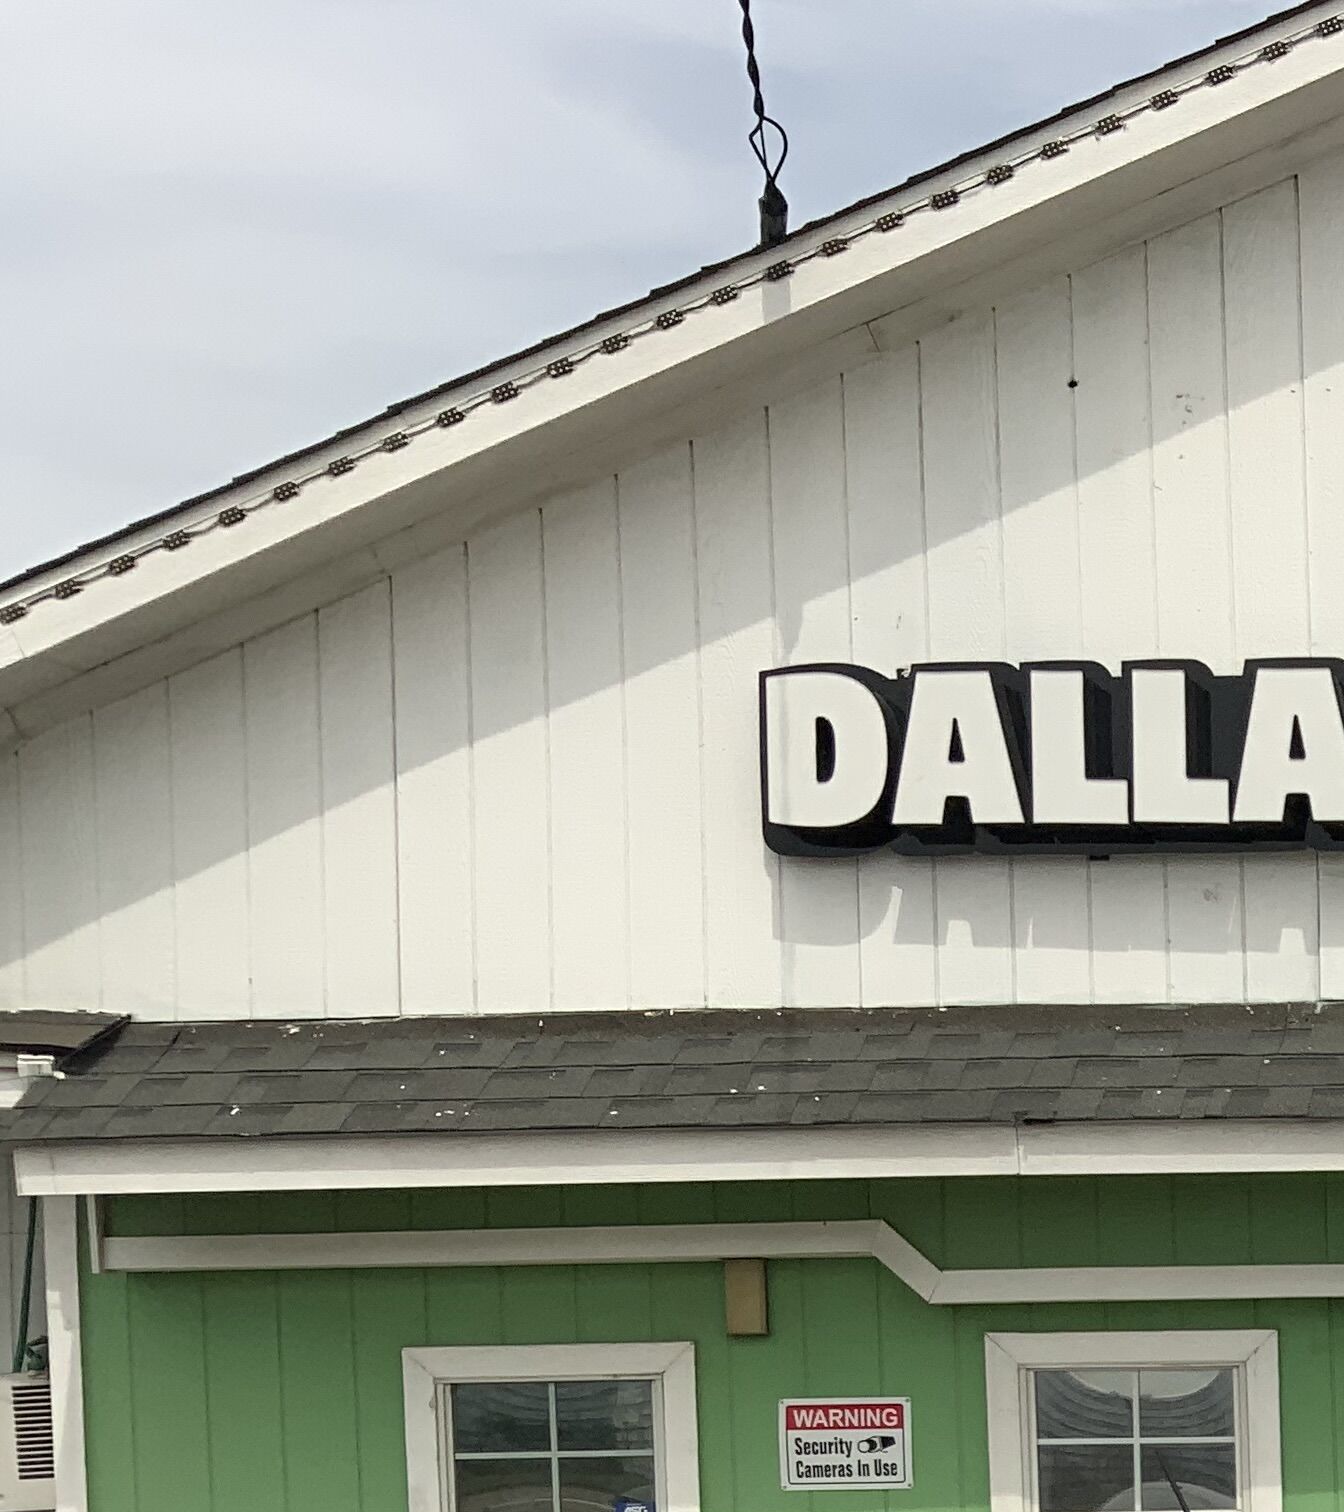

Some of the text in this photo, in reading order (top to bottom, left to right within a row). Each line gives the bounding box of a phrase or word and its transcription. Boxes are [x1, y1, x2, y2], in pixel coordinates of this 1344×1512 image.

[793, 1408, 898, 1428] WARNING
[794, 1437, 852, 1458] Security
[796, 1459, 898, 1479] Cameras In Use
